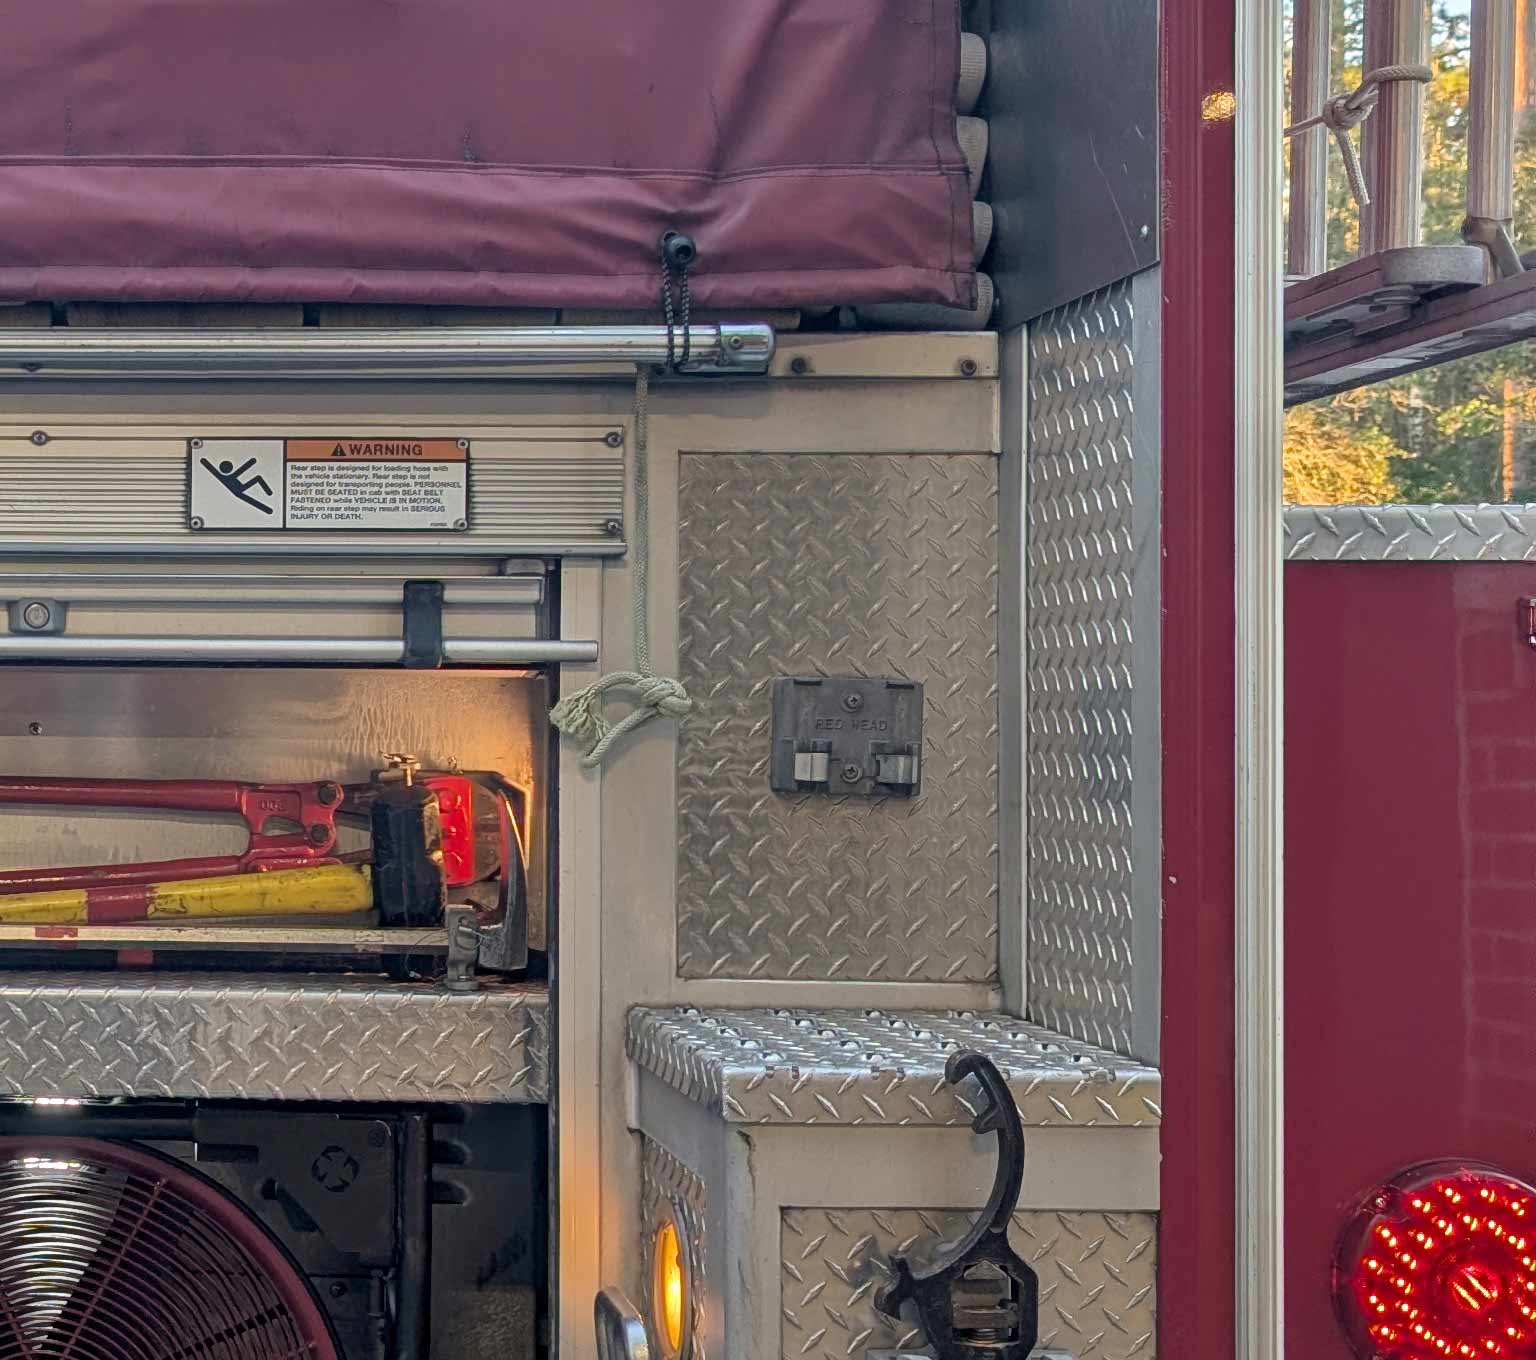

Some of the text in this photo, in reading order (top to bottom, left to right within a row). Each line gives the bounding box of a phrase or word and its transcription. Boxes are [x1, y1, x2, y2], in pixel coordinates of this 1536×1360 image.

[348, 443, 423, 456] WARNING
[815, 718, 889, 732] RED HEAD
